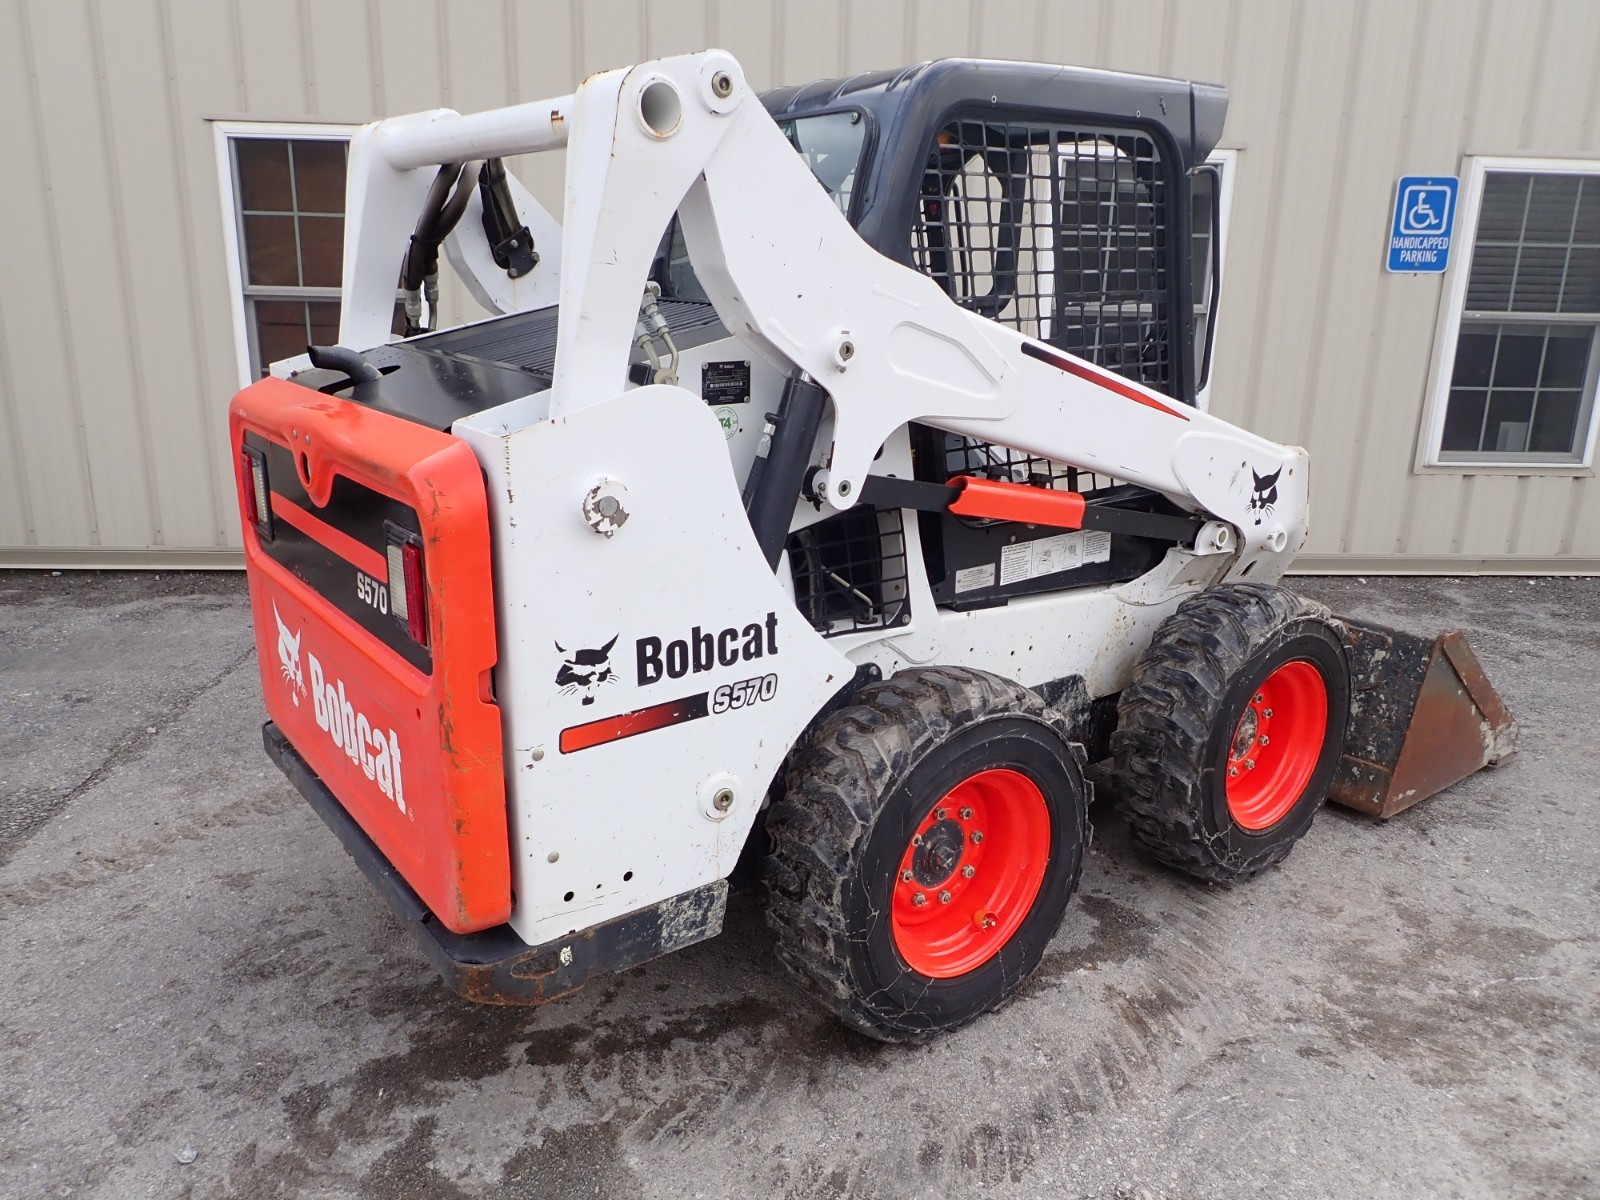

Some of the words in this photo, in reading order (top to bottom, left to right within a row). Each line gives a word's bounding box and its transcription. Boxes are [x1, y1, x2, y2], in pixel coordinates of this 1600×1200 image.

[1392, 236, 1449, 249] HANDICAPPED
[1400, 250, 1437, 262] PARKING
[356, 572, 388, 615] S570
[636, 611, 779, 687] Bobcat
[712, 673, 778, 714] S570
[307, 651, 406, 815] Bobcat
